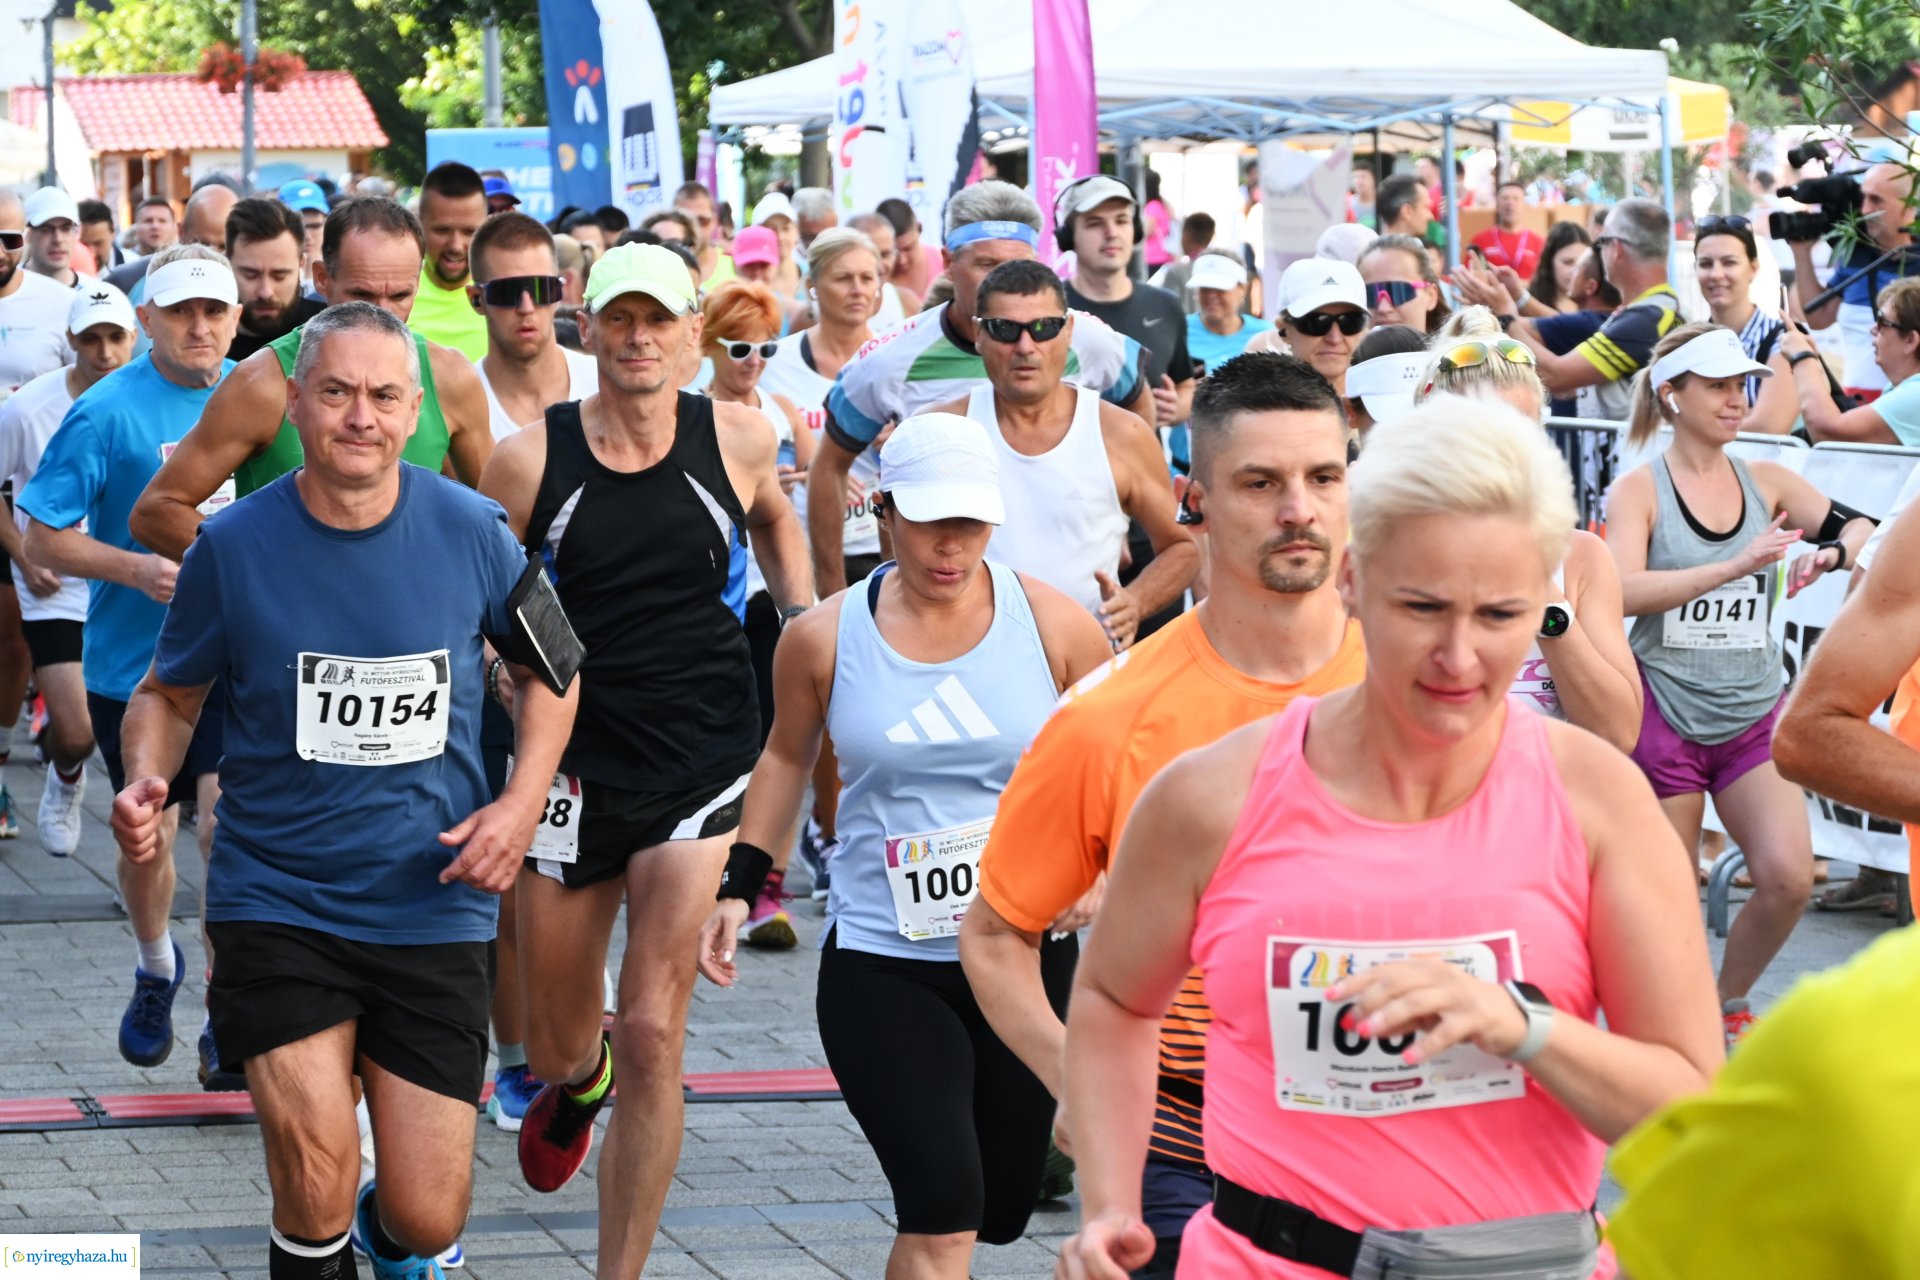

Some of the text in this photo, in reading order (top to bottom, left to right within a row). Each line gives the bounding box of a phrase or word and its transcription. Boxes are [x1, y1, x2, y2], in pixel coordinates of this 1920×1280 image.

[1679, 598, 1757, 622] 10141
[360, 673, 426, 685] FUTÓFESZTIVÁL
[317, 690, 438, 727] 10154
[905, 861, 980, 904] 100
